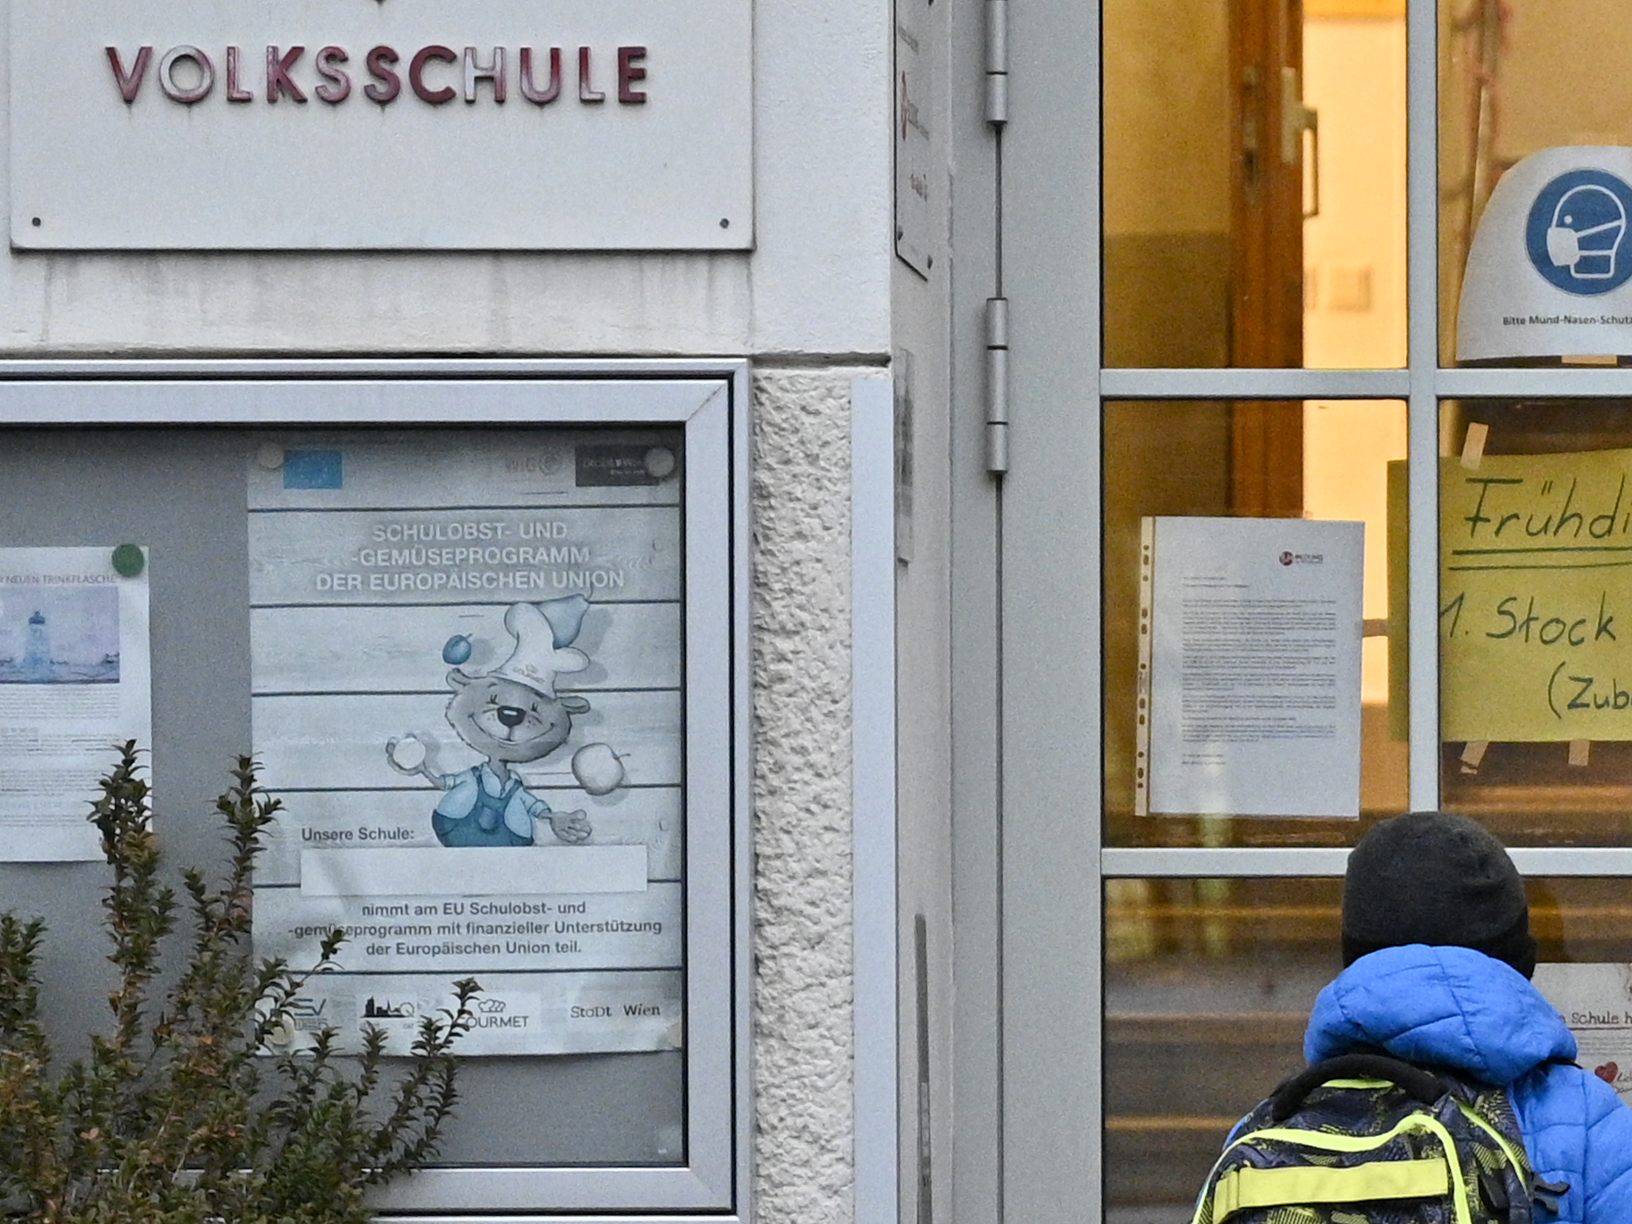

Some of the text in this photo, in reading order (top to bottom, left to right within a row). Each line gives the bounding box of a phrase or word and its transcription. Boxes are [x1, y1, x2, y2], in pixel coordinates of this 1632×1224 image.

[104, 45, 649, 104] VOLKSSCHULE
[1502, 315, 1526, 326] Bitte
[371, 521, 568, 541] SCHULOBST- UND
[350, 544, 590, 567] -GEMÜSEPROGRAMM
[315, 569, 625, 592] DER EUROPÄISCHEN UNION
[1440, 591, 1617, 646] 1. Stock
[301, 826, 415, 842] Unsere Schule:
[361, 901, 587, 917] nimmt am EU Schulobst- und
[436, 921, 462, 936] mit
[465, 920, 549, 936] finanzieller
[554, 919, 663, 936] Unterstützung
[365, 940, 582, 959] der Europäischen Union teil.
[462, 1015, 529, 1029] OURMET
[624, 1004, 661, 1017] Wien
[1571, 1010, 1620, 1025] Schule
